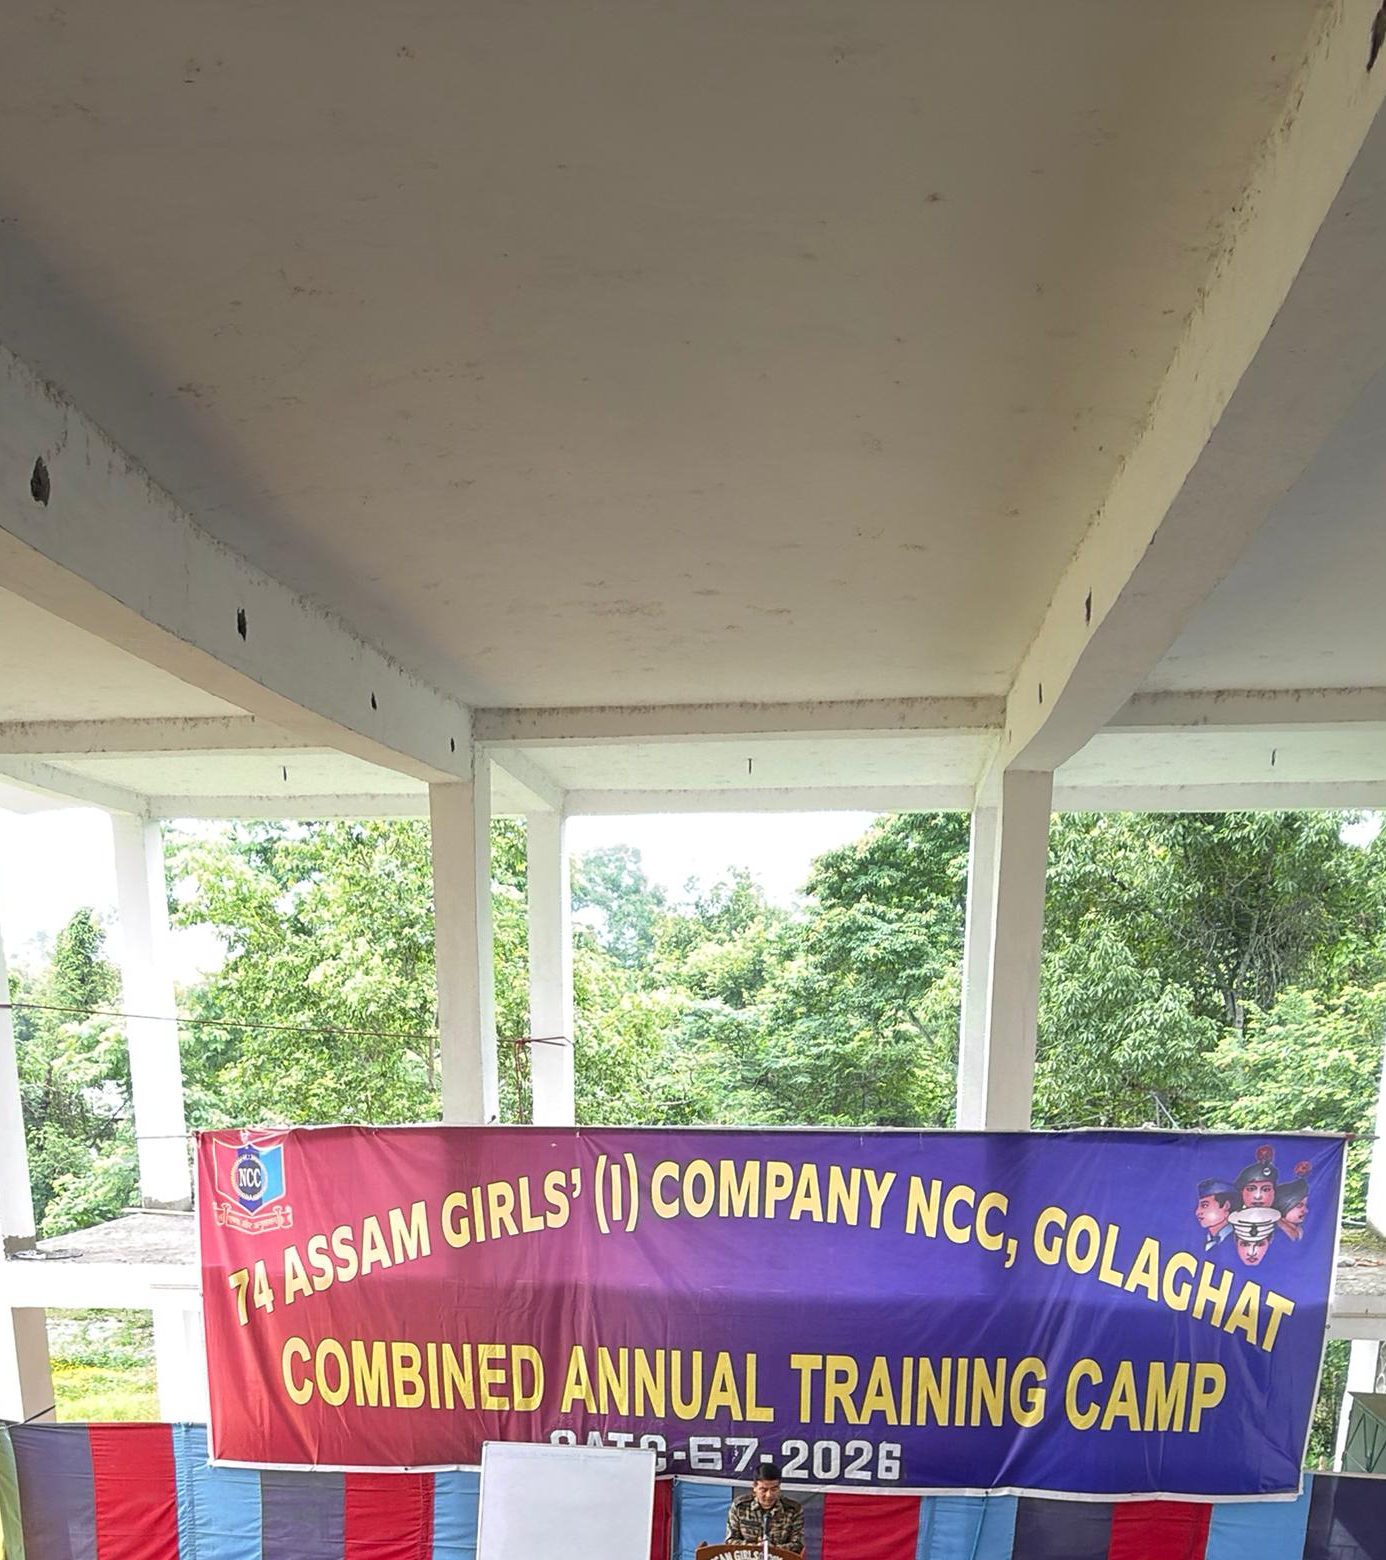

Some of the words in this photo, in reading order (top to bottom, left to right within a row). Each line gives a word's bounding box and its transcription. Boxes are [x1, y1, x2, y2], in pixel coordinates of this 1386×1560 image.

[237, 1167, 262, 1188] NCC
[227, 1258, 274, 1326] 74
[282, 1201, 430, 1305] ASSAM
[595, 1152, 639, 1232] (I)
[650, 1159, 896, 1230] COMPANY
[906, 1176, 1018, 1270] NCC,
[1033, 1206, 1296, 1353] GOLAGHAT
[281, 1336, 546, 1413] COMBINED
[559, 1344, 775, 1424] ANNUAL
[790, 1353, 1047, 1429] TRAINING
[1065, 1358, 1229, 1434] CAMP
